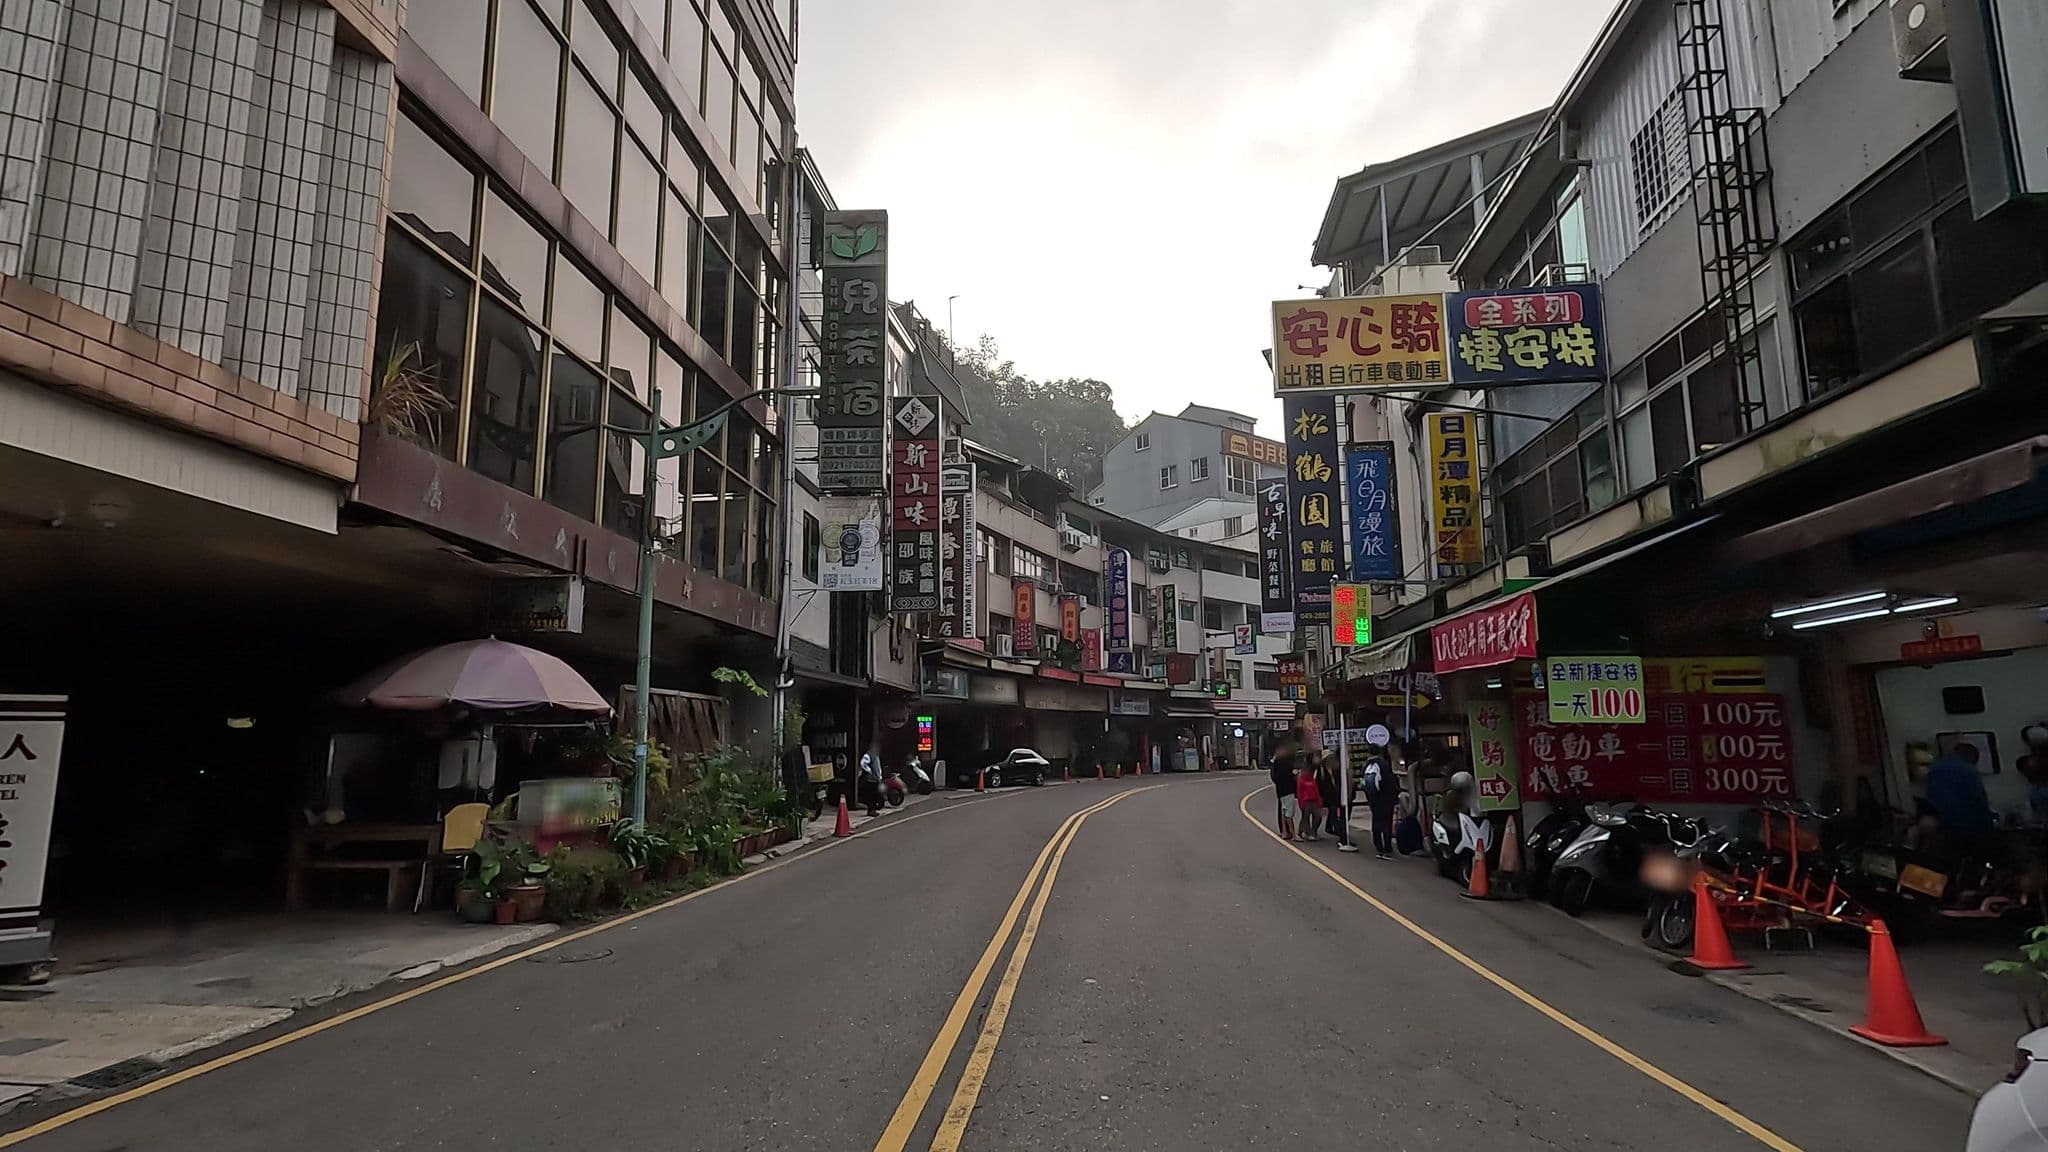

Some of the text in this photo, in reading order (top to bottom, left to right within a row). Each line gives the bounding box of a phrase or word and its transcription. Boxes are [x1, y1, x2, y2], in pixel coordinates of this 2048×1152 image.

[1478, 294, 1571, 326] 全系列
[1280, 301, 1440, 358] 安心騎
[1457, 322, 1597, 374] 捷安特
[1283, 362, 1443, 387] 出租自行車電動車
[1292, 407, 1334, 529] 松鶴園
[1551, 661, 1639, 683] 全新捷安特
[1701, 702, 1783, 728] 100元
[1529, 733, 1625, 763] 電動車
[1702, 734, 1787, 761] 00元
[1705, 767, 1790, 795] 300元
